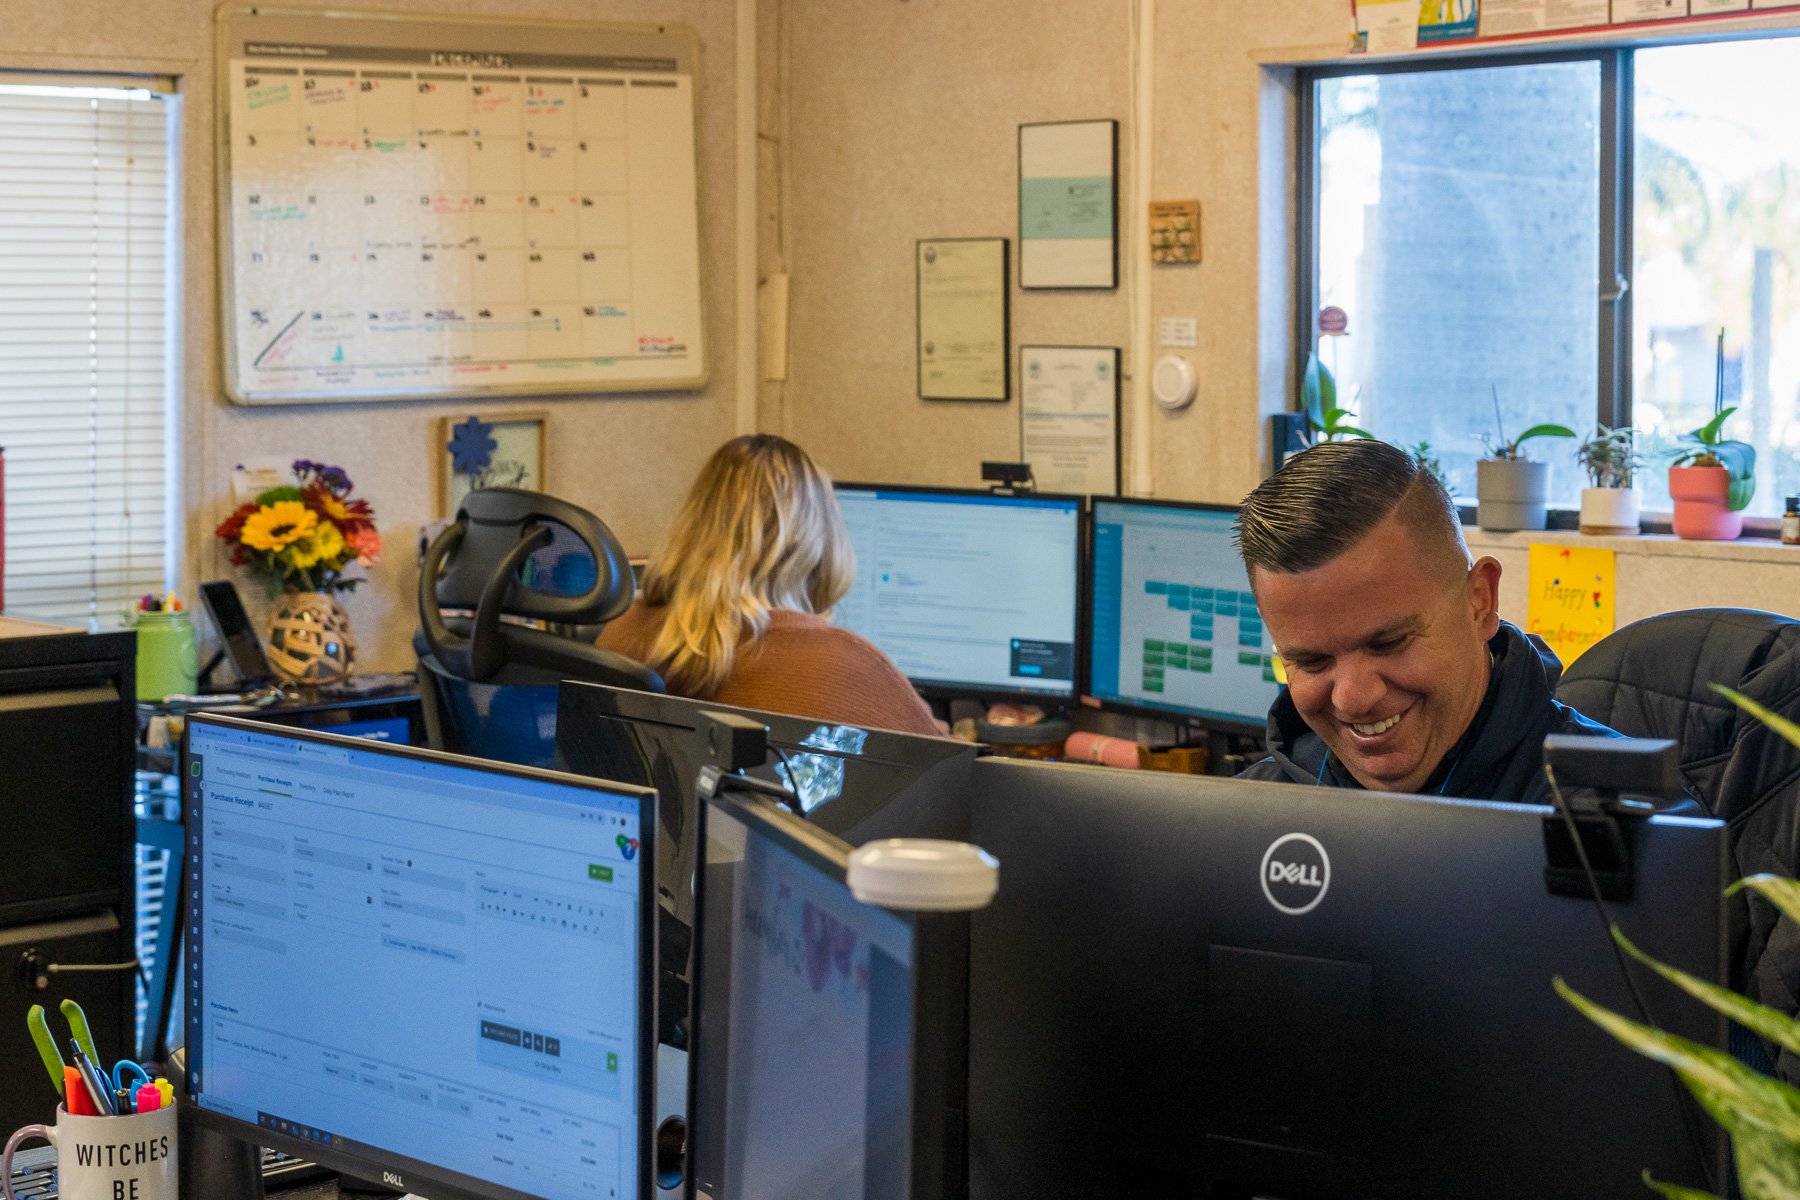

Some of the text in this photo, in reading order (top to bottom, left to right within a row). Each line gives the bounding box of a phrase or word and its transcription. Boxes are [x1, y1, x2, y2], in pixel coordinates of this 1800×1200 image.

[210, 791, 234, 803] Purchase
[234, 796, 254, 808] Receipt
[1269, 860, 1322, 887] DELL
[76, 1135, 168, 1168] WITCHES
[113, 1178, 139, 1200] BE
[383, 1170, 404, 1187] DELL
